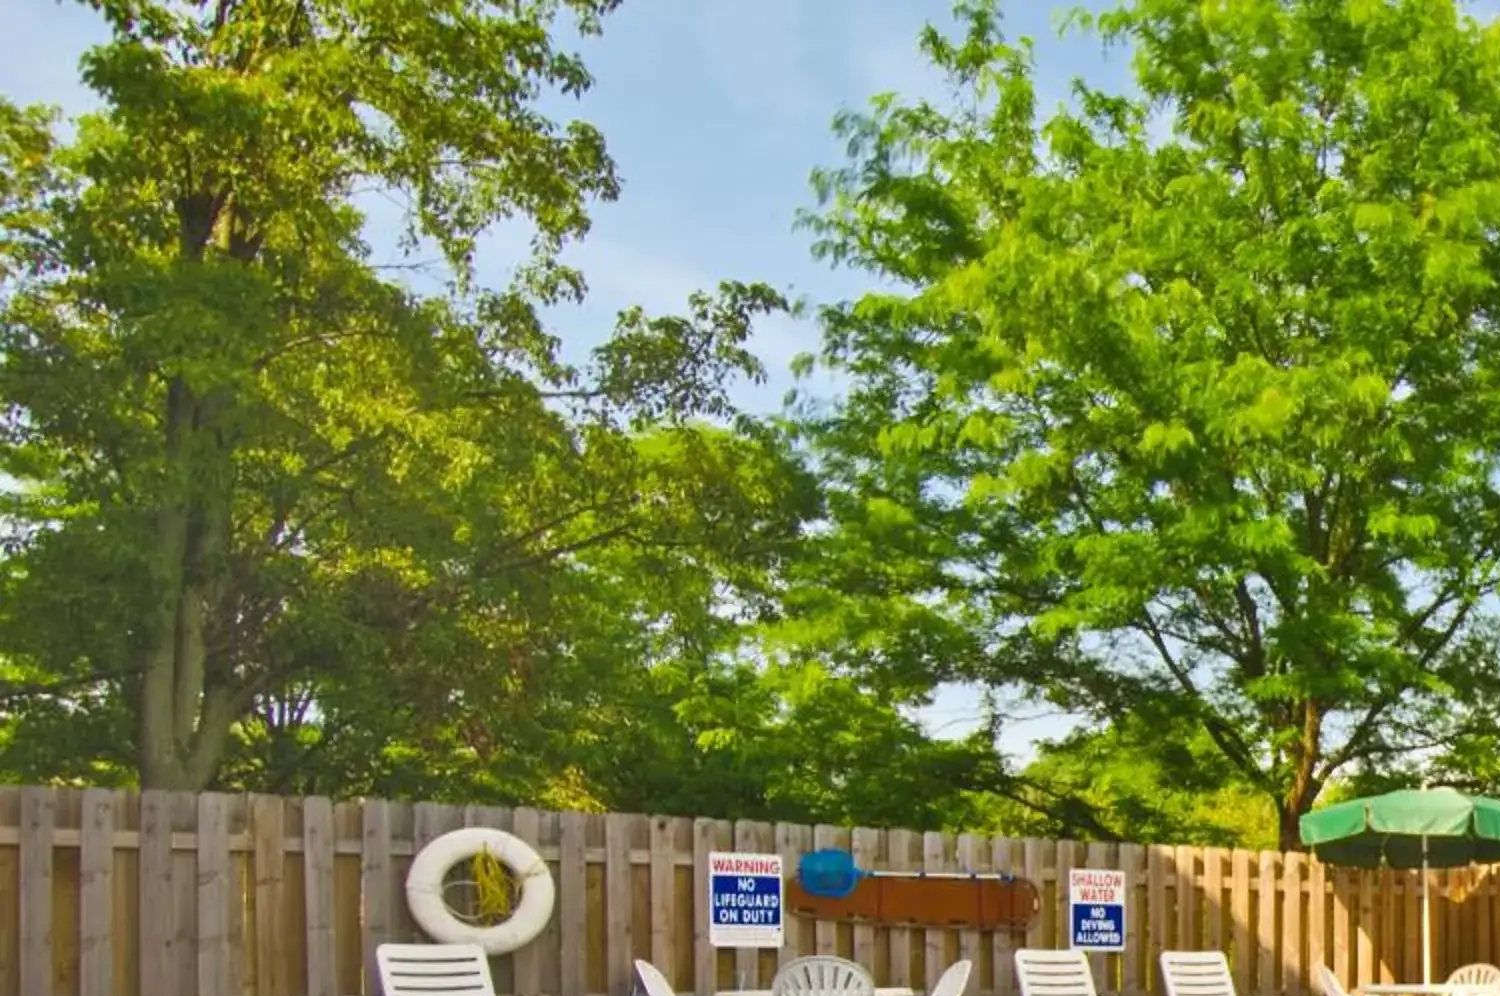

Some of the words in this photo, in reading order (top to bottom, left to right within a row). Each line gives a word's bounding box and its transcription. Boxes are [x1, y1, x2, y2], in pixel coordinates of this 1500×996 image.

[713, 859, 780, 874] WARNING
[737, 877, 755, 892] NO
[1072, 873, 1121, 887] SHALLOW
[714, 893, 779, 908] LIFEGUARD
[1080, 888, 1115, 902] WATER
[719, 909, 738, 923] ON
[743, 909, 774, 923] DUTY
[1090, 906, 1106, 918] NO
[1081, 919, 1115, 931] DIVING
[1076, 932, 1121, 944] ALLOWED
